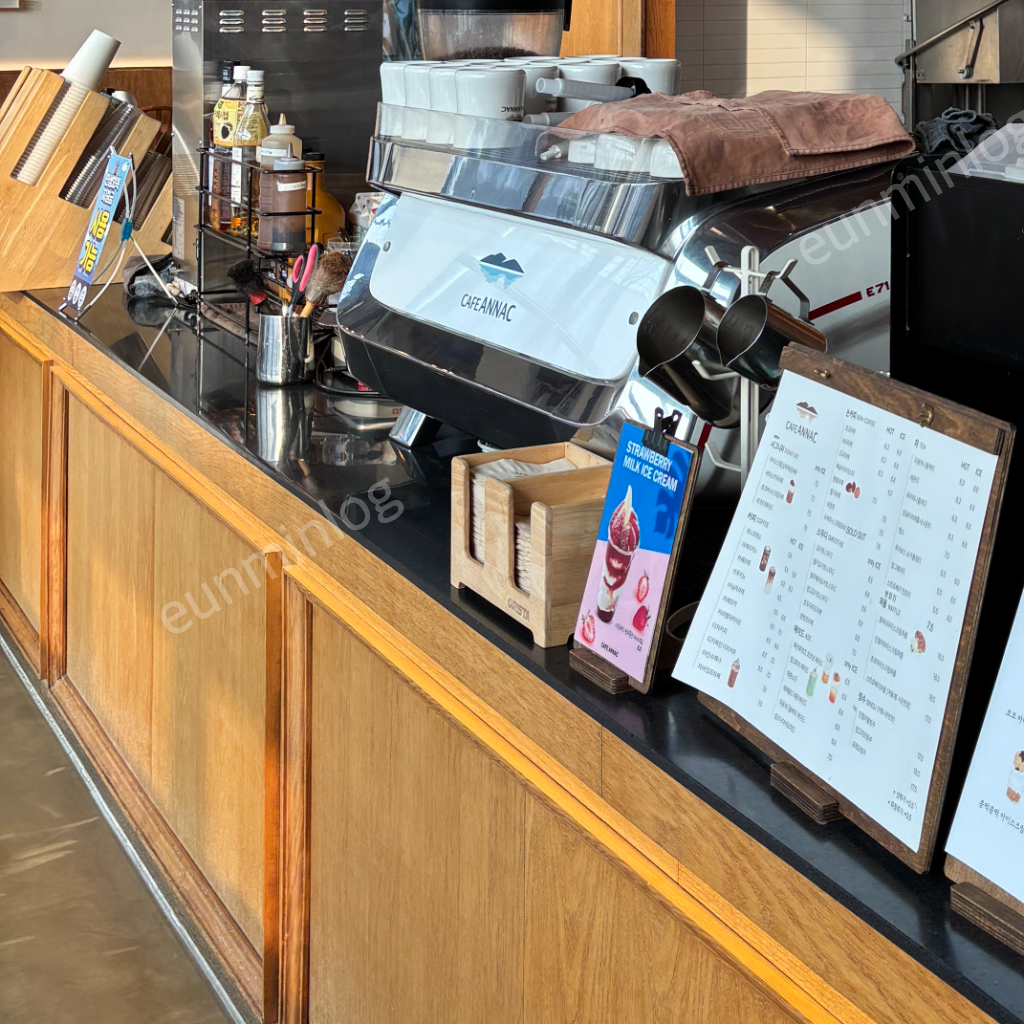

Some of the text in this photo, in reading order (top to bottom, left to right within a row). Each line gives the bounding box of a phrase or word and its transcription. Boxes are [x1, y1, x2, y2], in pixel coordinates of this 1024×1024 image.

[784, 420, 818, 443] CAFEANNAC
[626, 440, 673, 472] STRAWBERRY
[623, 455, 678, 493] MILK ICE CREAM
[747, 511, 756, 522] 커피
[1005, 708, 1016, 720] 초코
[999, 811, 1024, 835] 아이스크림
